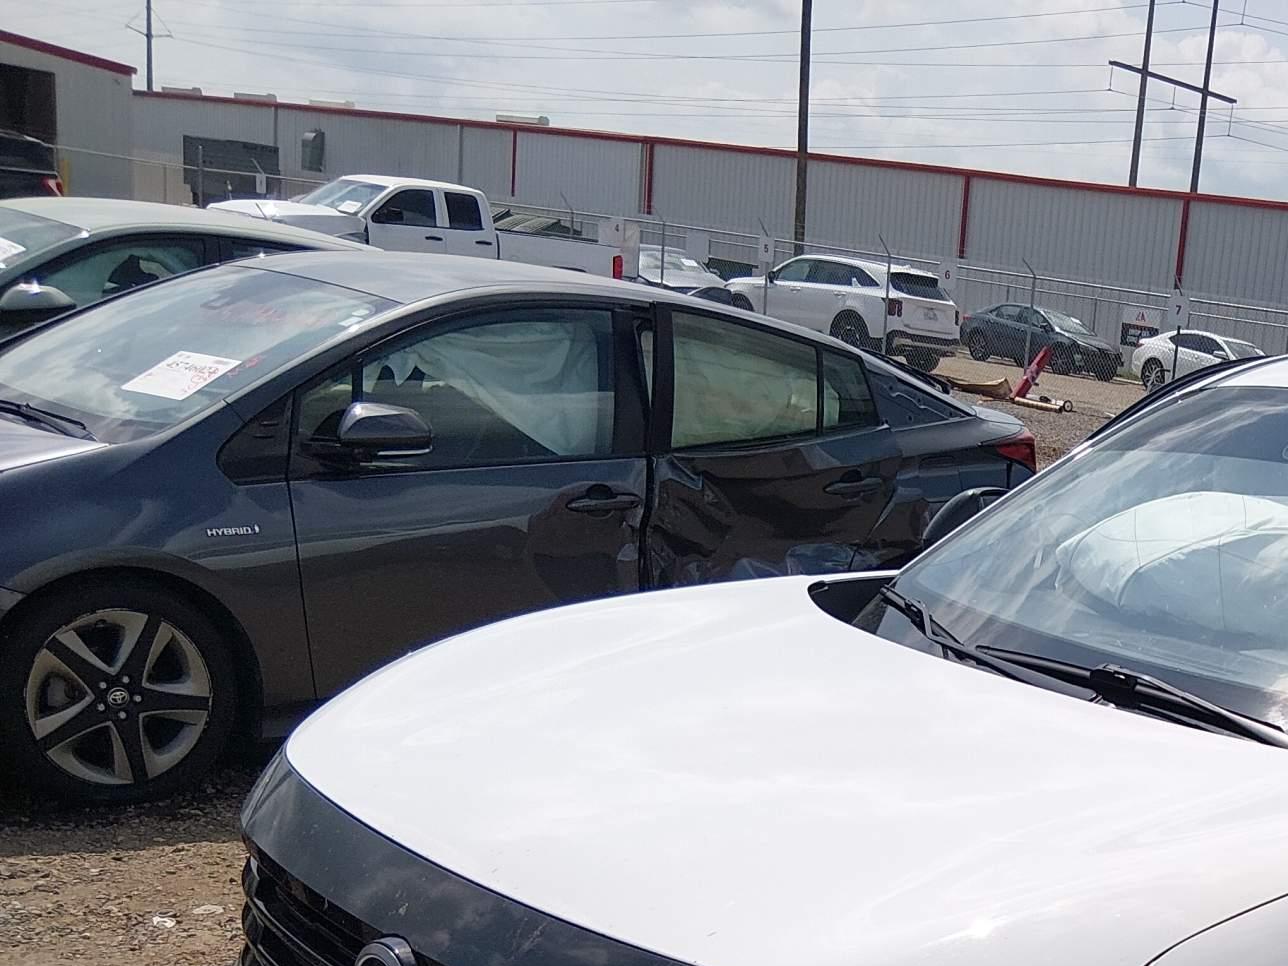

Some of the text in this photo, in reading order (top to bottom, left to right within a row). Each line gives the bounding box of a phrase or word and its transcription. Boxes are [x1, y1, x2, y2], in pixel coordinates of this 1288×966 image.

[944, 269, 951, 280] 6
[1175, 304, 1183, 316] 7
[206, 525, 253, 537] HYBRID
